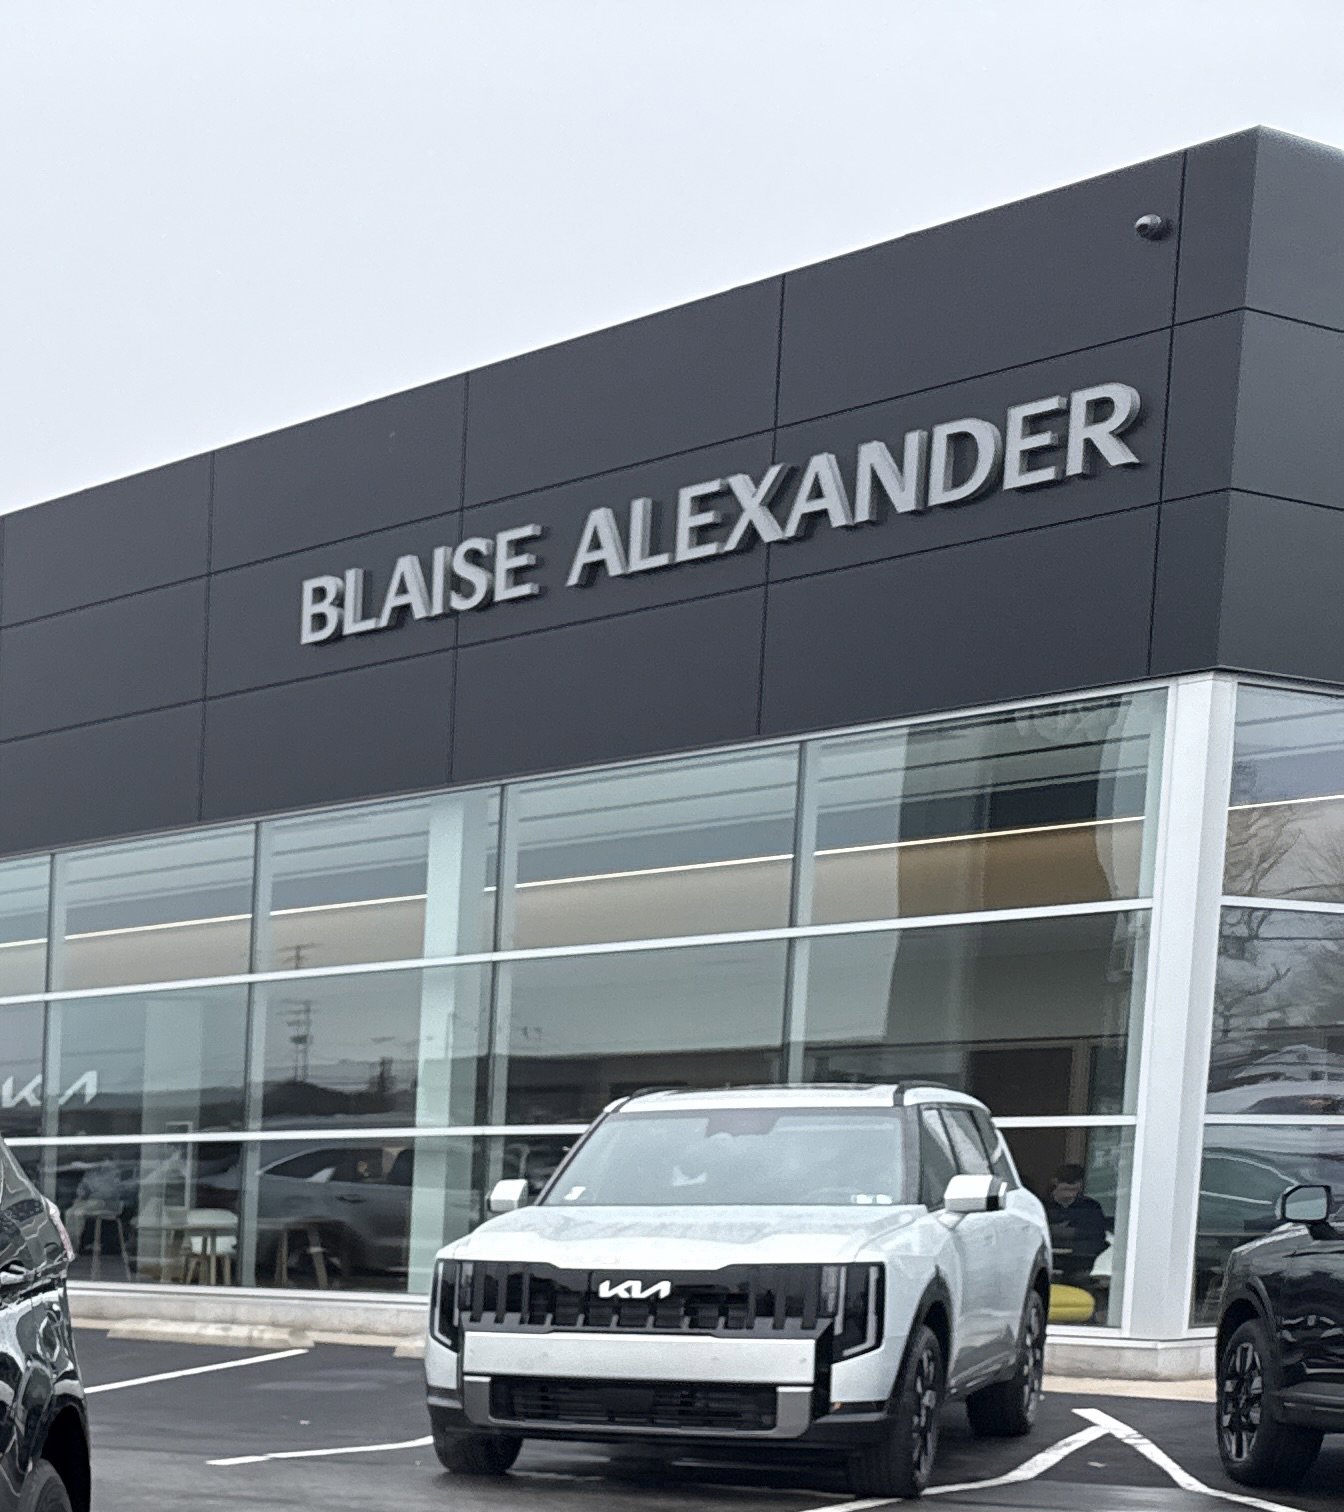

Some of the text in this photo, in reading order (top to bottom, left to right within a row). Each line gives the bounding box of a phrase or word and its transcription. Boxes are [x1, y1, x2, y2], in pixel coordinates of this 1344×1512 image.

[299, 381, 1142, 645] BLAISE ALEXANDER
[598, 1279, 672, 1300] KIA
